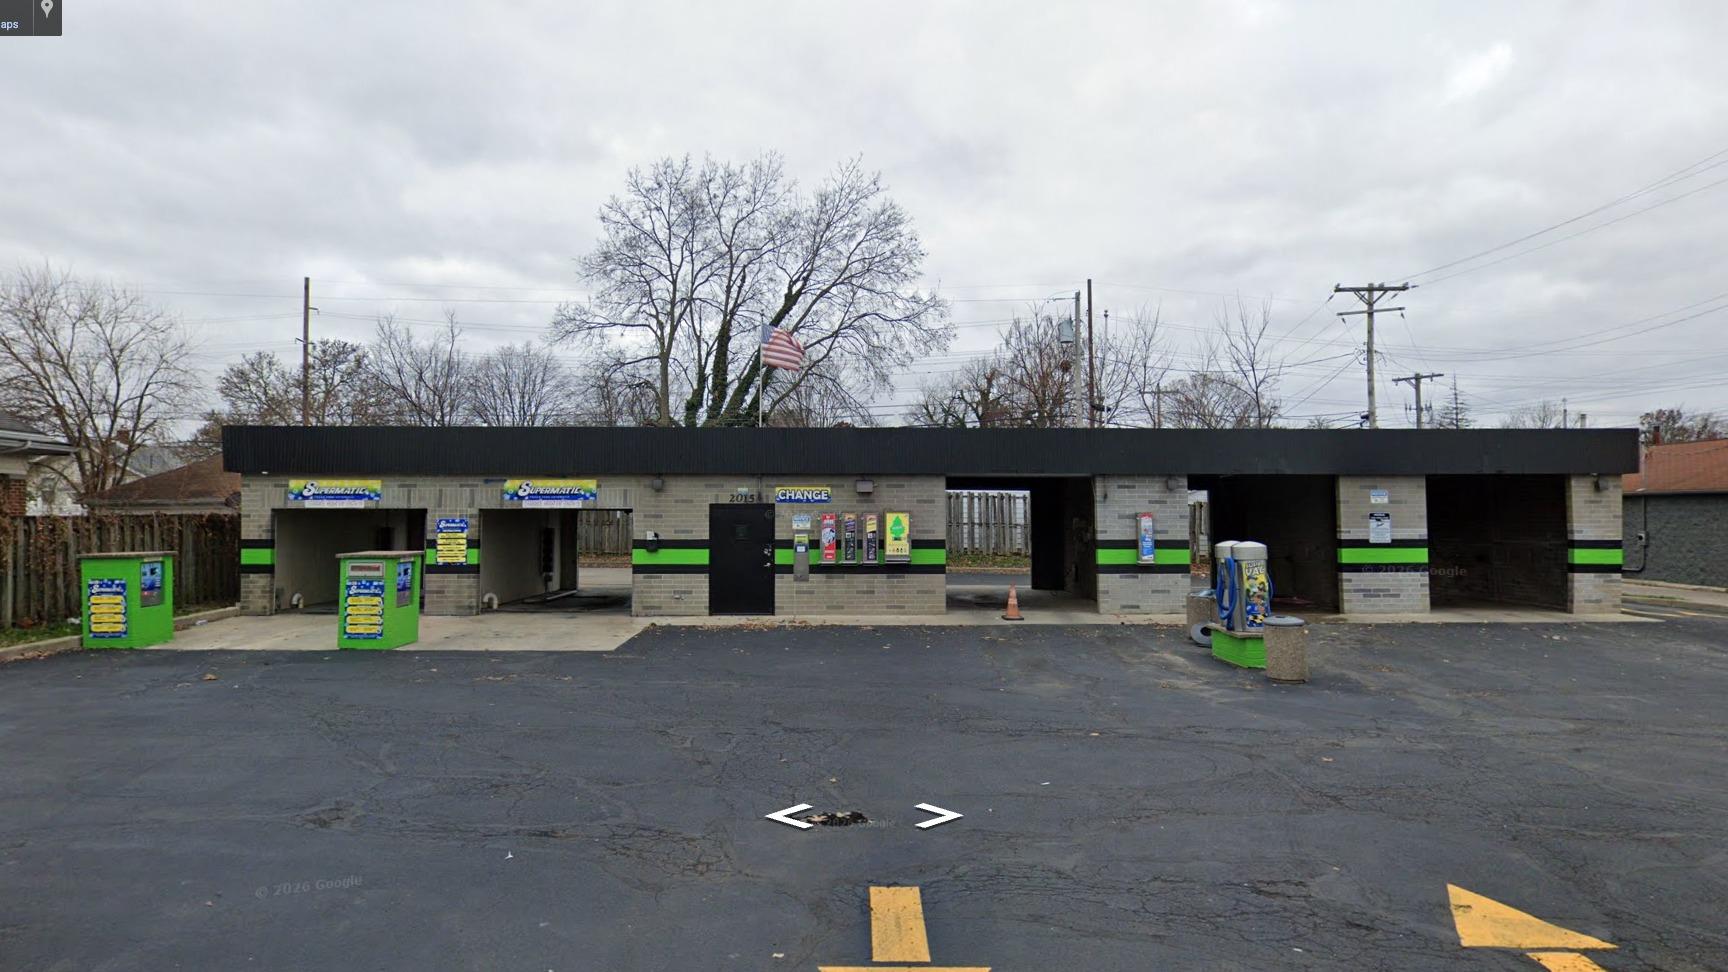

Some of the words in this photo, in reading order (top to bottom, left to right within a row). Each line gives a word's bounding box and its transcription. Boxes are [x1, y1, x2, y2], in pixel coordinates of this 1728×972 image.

[518, 480, 584, 497] SUPERMATIC
[729, 493, 755, 503] 2015
[778, 489, 829, 501] CHANGE
